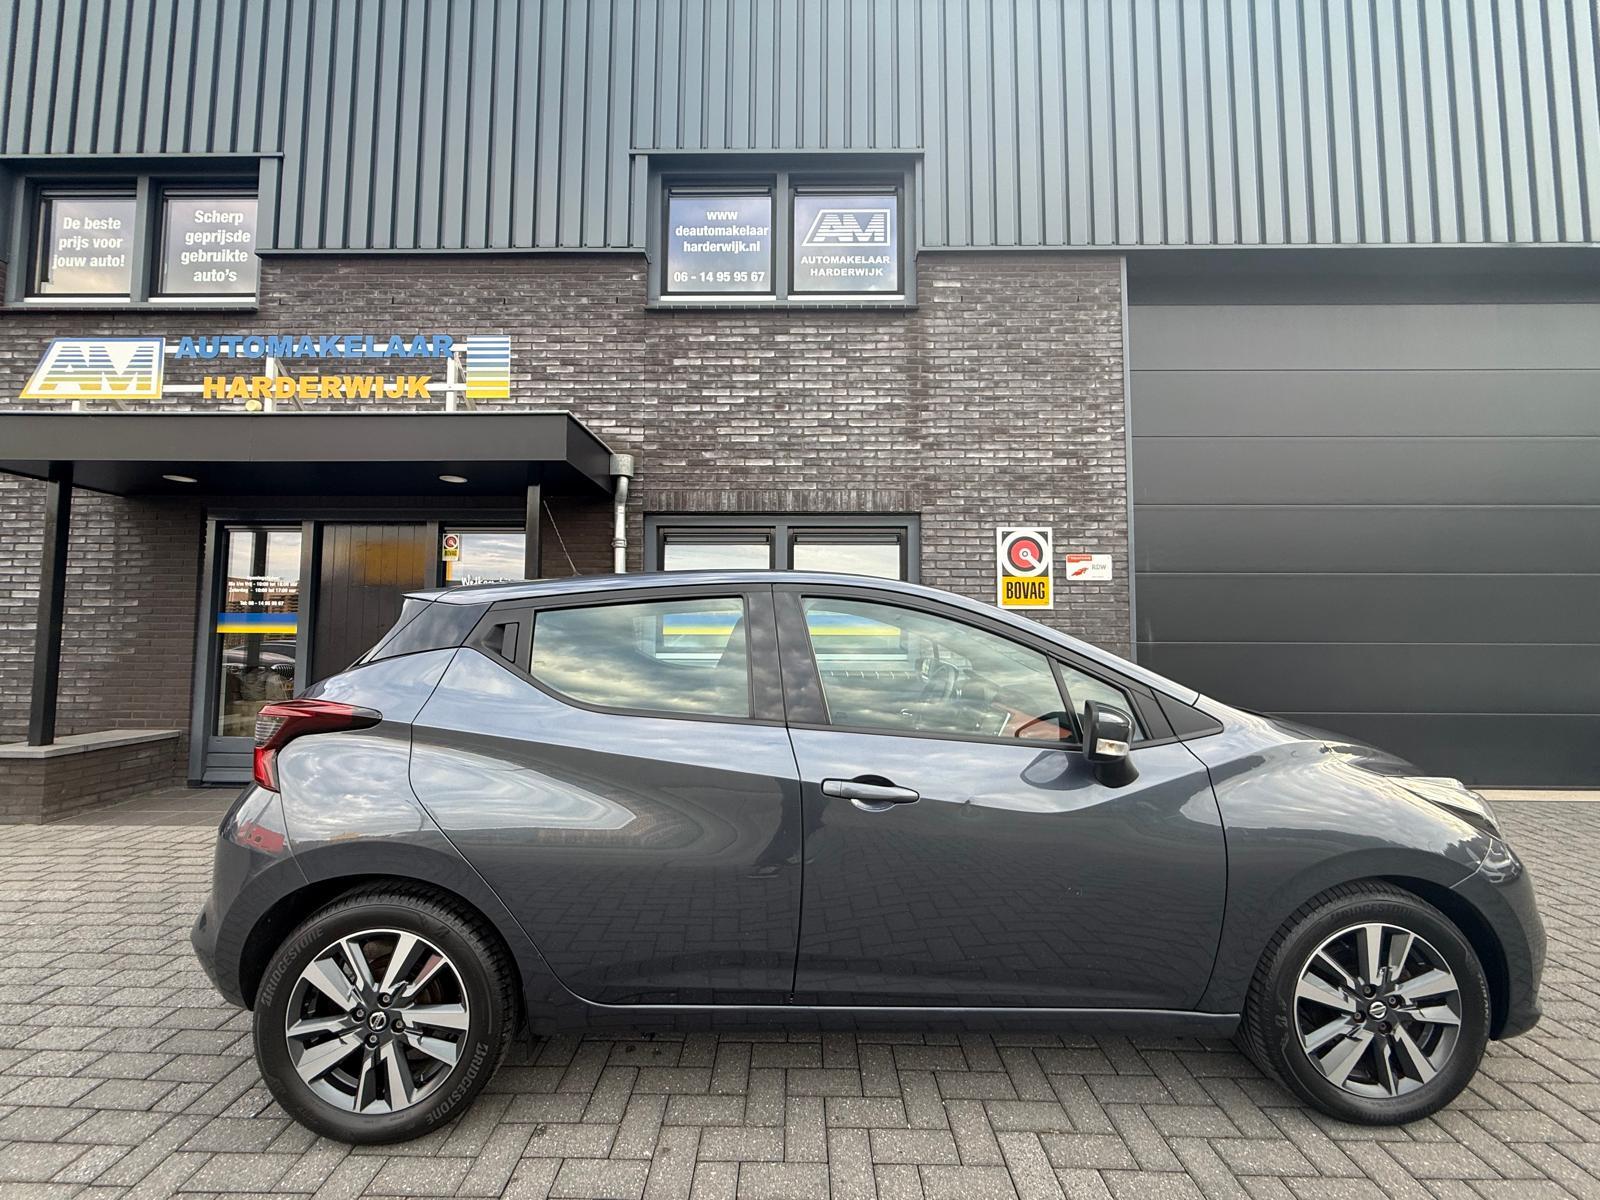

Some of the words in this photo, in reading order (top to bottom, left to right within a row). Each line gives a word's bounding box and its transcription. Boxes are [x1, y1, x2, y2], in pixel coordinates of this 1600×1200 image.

[63, 216, 81, 230] De
[84, 216, 121, 230] beste
[194, 209, 244, 226] Scherp
[706, 210, 738, 221] www
[675, 225, 769, 237] deautomakelaar
[812, 213, 885, 242] AM
[58, 235, 89, 250] prijs
[93, 237, 123, 249] voor
[185, 229, 251, 246] geprijsde
[683, 240, 760, 253] harderwijk.nl
[52, 254, 86, 269] jouw
[90, 253, 125, 268] auto!
[181, 248, 248, 265] gebruikte
[801, 255, 890, 264] AUTOMAKELAAR
[193, 268, 237, 282] auto's
[673, 271, 688, 282] 06
[699, 271, 713, 282] 14
[716, 271, 731, 282] 95
[733, 271, 748, 282] 95
[750, 271, 765, 282] 67
[810, 267, 884, 277] HARDERWIJK
[174, 335, 454, 359] AUTOMAKELAAR
[38, 345, 154, 391] AM
[203, 375, 432, 399] HARDERWIJK
[1006, 581, 1045, 600] BOVAG
[260, 925, 324, 1008] BRIDGESTONE
[425, 1041, 489, 1126] BRIDGESTONE
